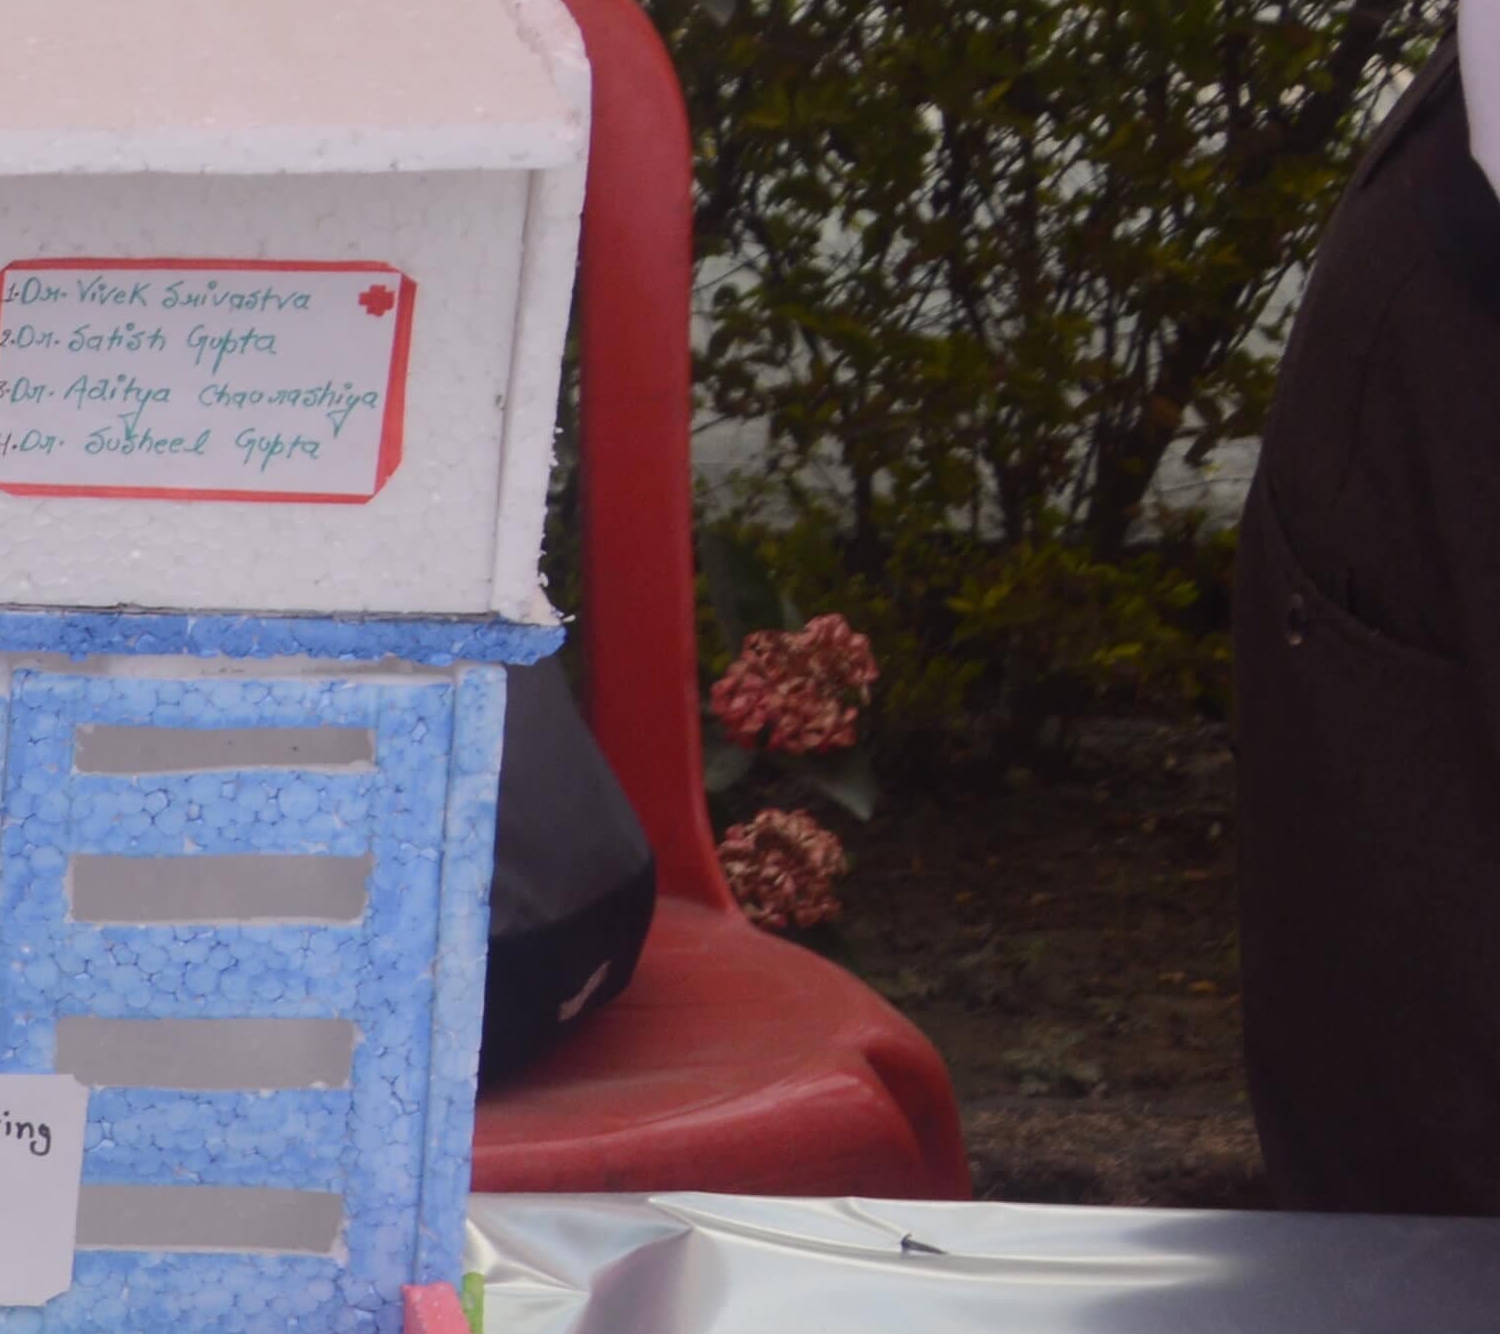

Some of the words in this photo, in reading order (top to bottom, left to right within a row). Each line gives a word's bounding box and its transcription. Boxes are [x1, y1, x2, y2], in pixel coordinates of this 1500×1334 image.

[67, 322, 167, 353] Satish
[186, 323, 278, 374] Gupta
[63, 373, 172, 437] Aditya
[234, 429, 321, 473] Gupta
